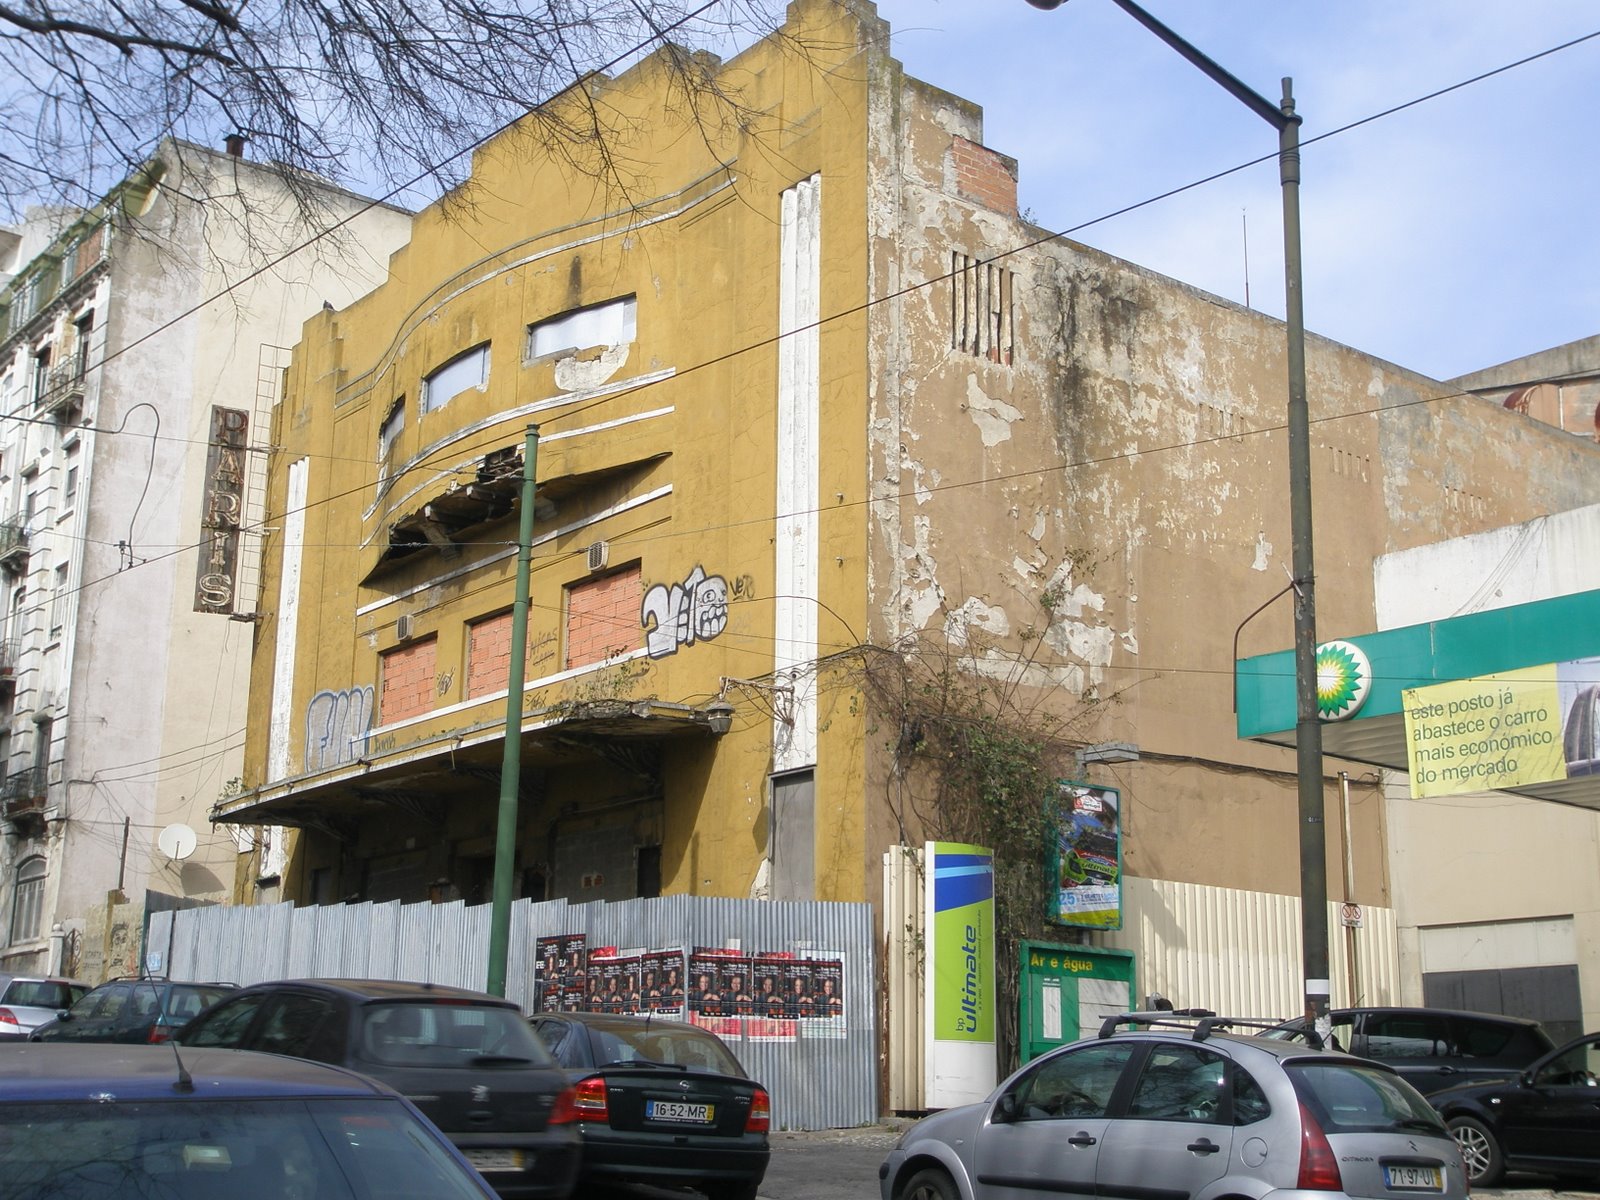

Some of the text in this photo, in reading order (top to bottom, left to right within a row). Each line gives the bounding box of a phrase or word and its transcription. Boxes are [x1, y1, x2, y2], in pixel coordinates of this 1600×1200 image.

[199, 408, 248, 606] PARIS
[1411, 686, 1513, 720] este posto já
[1413, 708, 1548, 741] abastece o carro
[1415, 729, 1552, 763] mais económico
[1416, 757, 1518, 784] do mercado
[962, 925, 976, 1033] ultimate
[1031, 953, 1093, 972] Ar e água
[956, 1018, 965, 1031] bp
